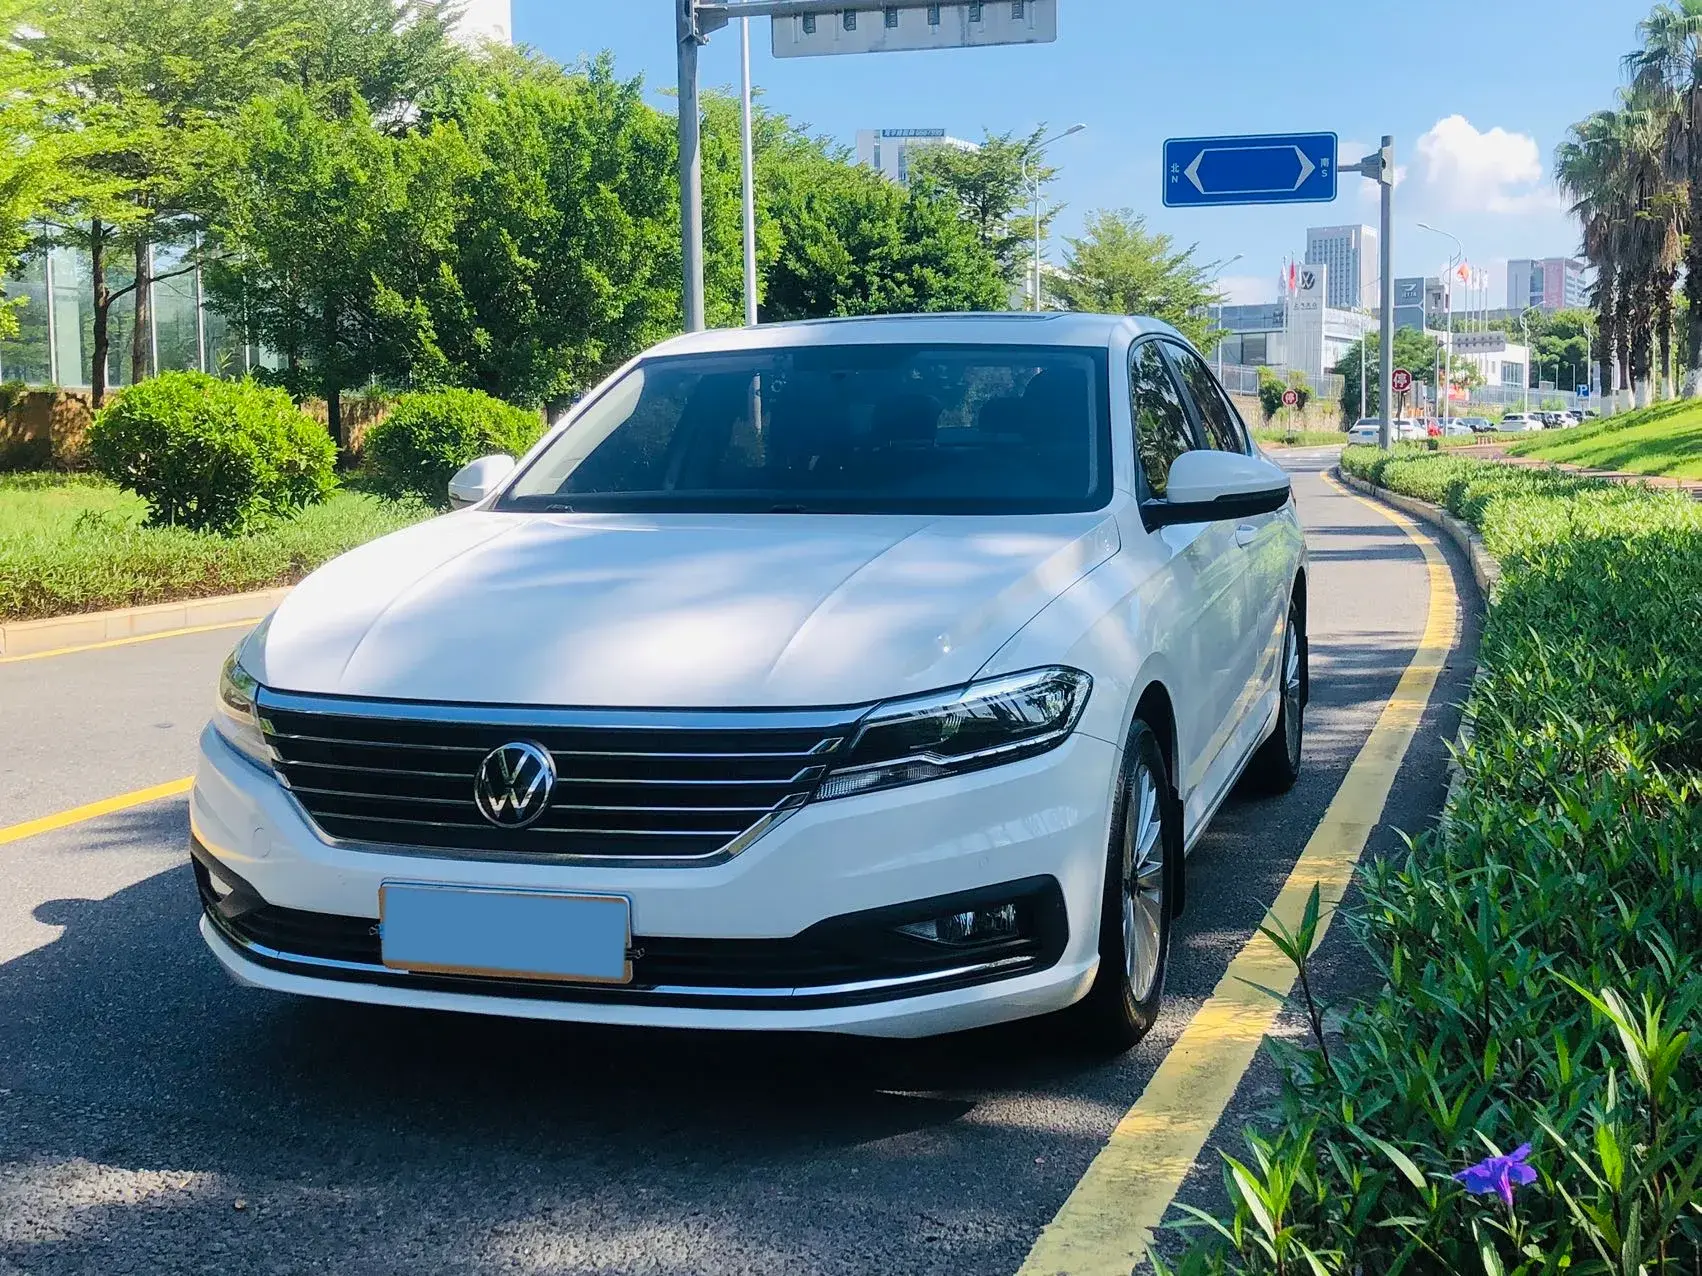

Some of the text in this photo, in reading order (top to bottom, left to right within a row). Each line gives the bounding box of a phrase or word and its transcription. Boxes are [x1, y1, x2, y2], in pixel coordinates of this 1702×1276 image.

[1170, 163, 1180, 174] 北
[1321, 169, 1328, 178] S
[1171, 175, 1179, 183] N
[1393, 372, 1408, 388] 停
[1578, 384, 1588, 397] P
